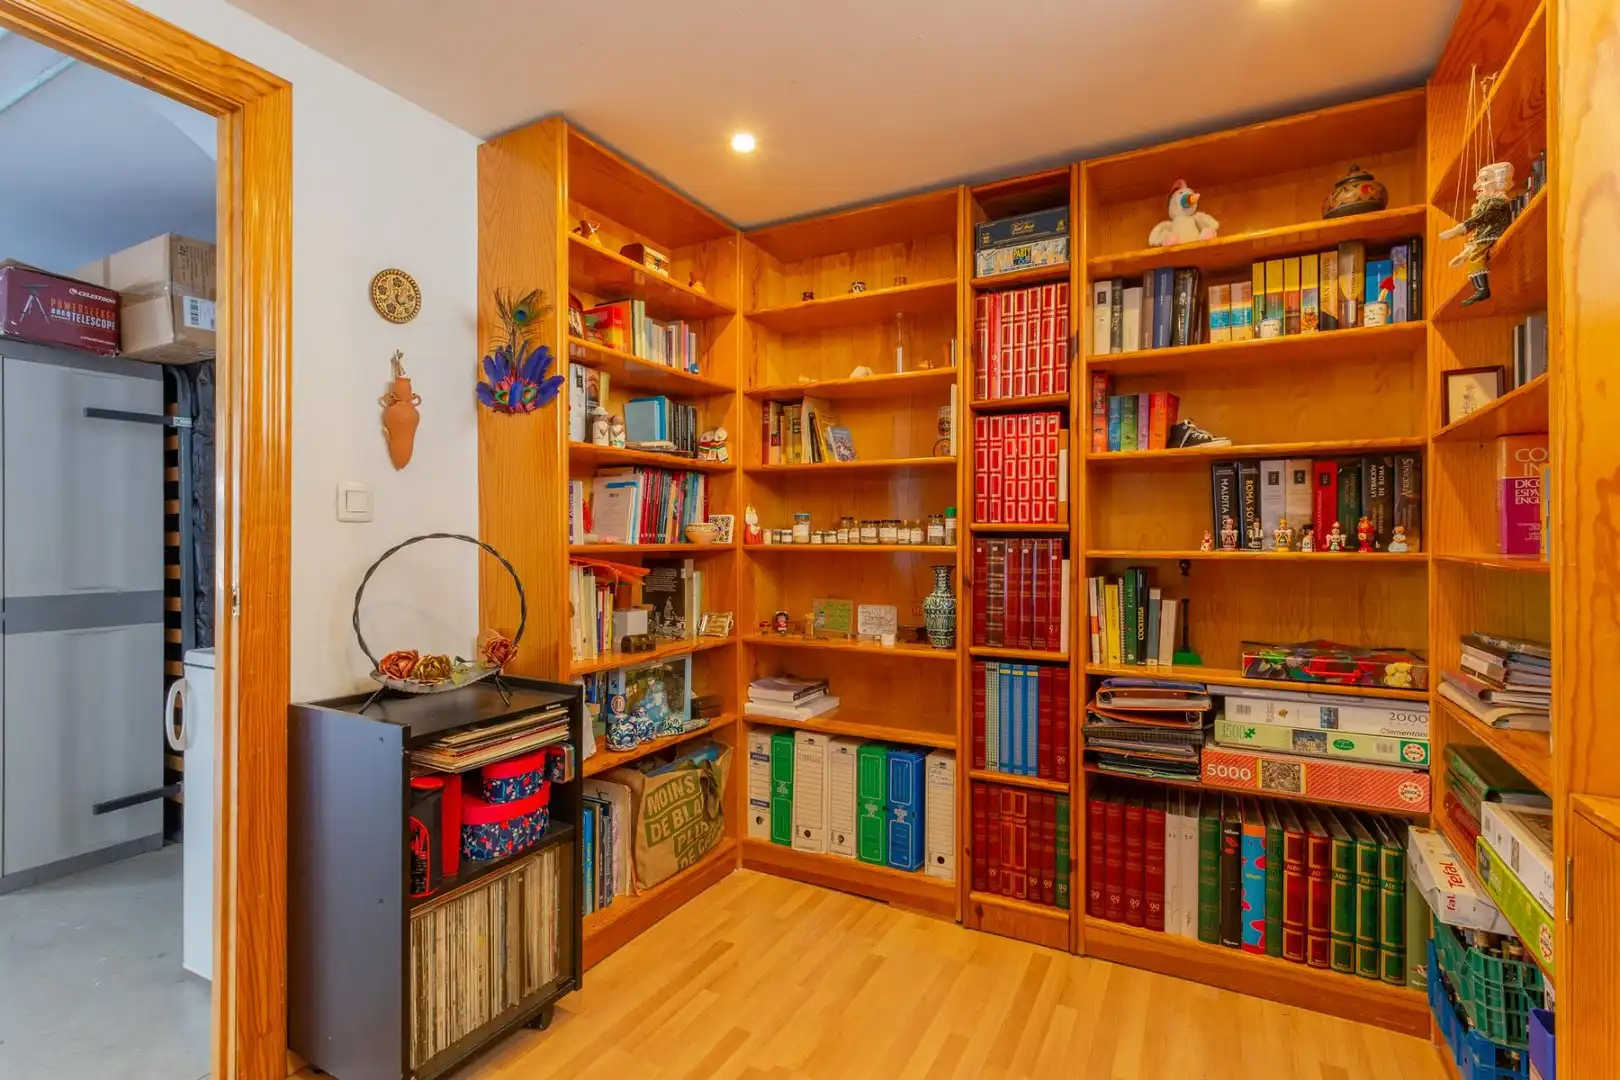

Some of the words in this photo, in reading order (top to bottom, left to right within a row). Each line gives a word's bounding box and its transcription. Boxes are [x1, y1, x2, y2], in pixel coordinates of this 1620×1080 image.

[78, 291, 116, 304] CELESTRON
[71, 312, 116, 330] TELESCOPE
[1400, 458, 1414, 498] AFRICANUS
[1220, 478, 1229, 513] MALDITA
[1245, 480, 1254, 504] ROMA
[1389, 712, 1428, 723] 2000
[1380, 727, 1427, 738] Clementoni
[1206, 763, 1251, 781] 5000
[647, 775, 695, 816] MOINS
[650, 816, 670, 843] DE
[1439, 862, 1465, 888] Tefal
